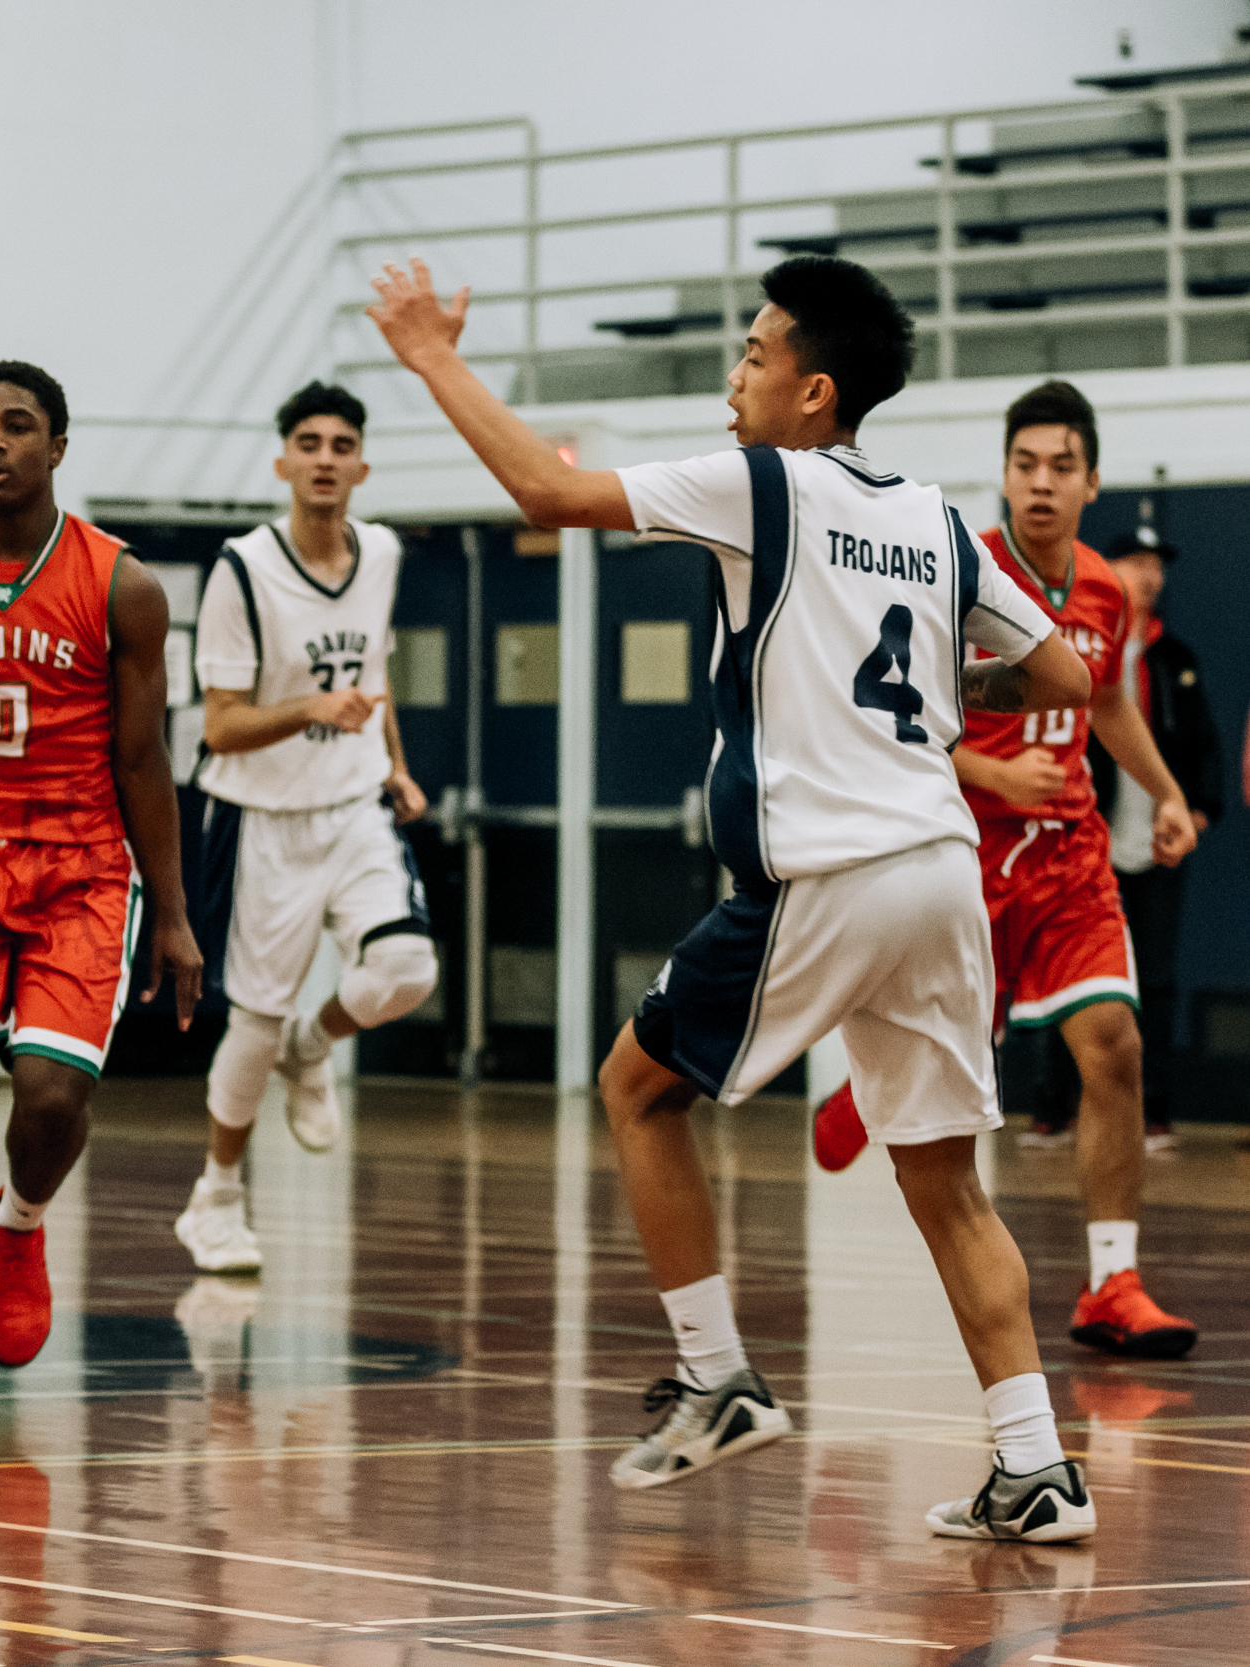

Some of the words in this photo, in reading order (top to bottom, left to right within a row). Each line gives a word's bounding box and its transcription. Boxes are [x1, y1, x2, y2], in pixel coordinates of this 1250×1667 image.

[827, 529, 937, 585] TROJANS
[305, 630, 367, 661] DAVID
[853, 604, 929, 744] 4
